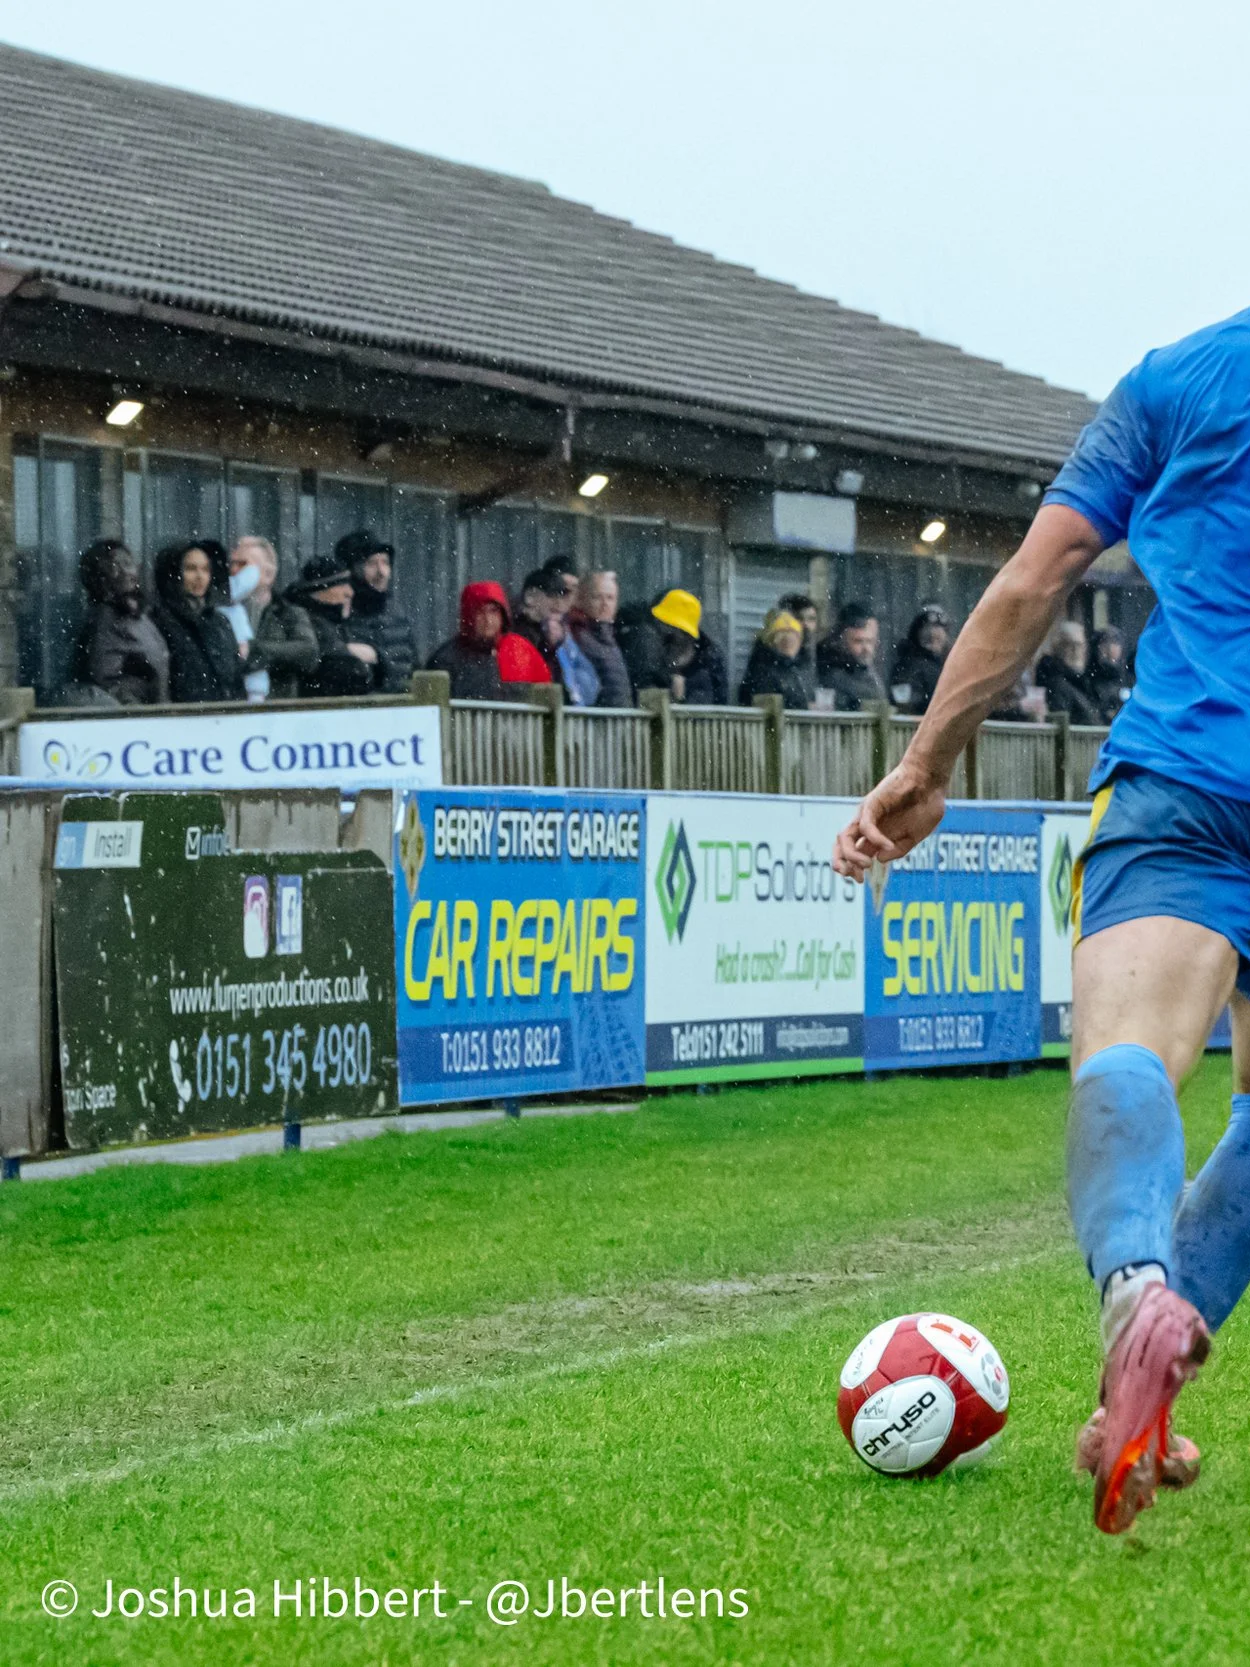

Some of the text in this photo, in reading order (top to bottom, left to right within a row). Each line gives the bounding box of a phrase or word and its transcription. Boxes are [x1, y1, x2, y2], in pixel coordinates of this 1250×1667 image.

[121, 732, 425, 777] Care Connect
[94, 825, 132, 858] Install
[434, 807, 639, 859] BERRY STREET GARAGE
[938, 833, 986, 872] STREET
[988, 835, 1038, 873] GARAGE
[404, 898, 637, 1001] CAR REPAIRS
[883, 901, 1024, 996] SERVICING
[197, 1022, 371, 1100] 0151 345 4980
[440, 1025, 560, 1073] T:0151 933 8812
[863, 1391, 936, 1456] chryso
